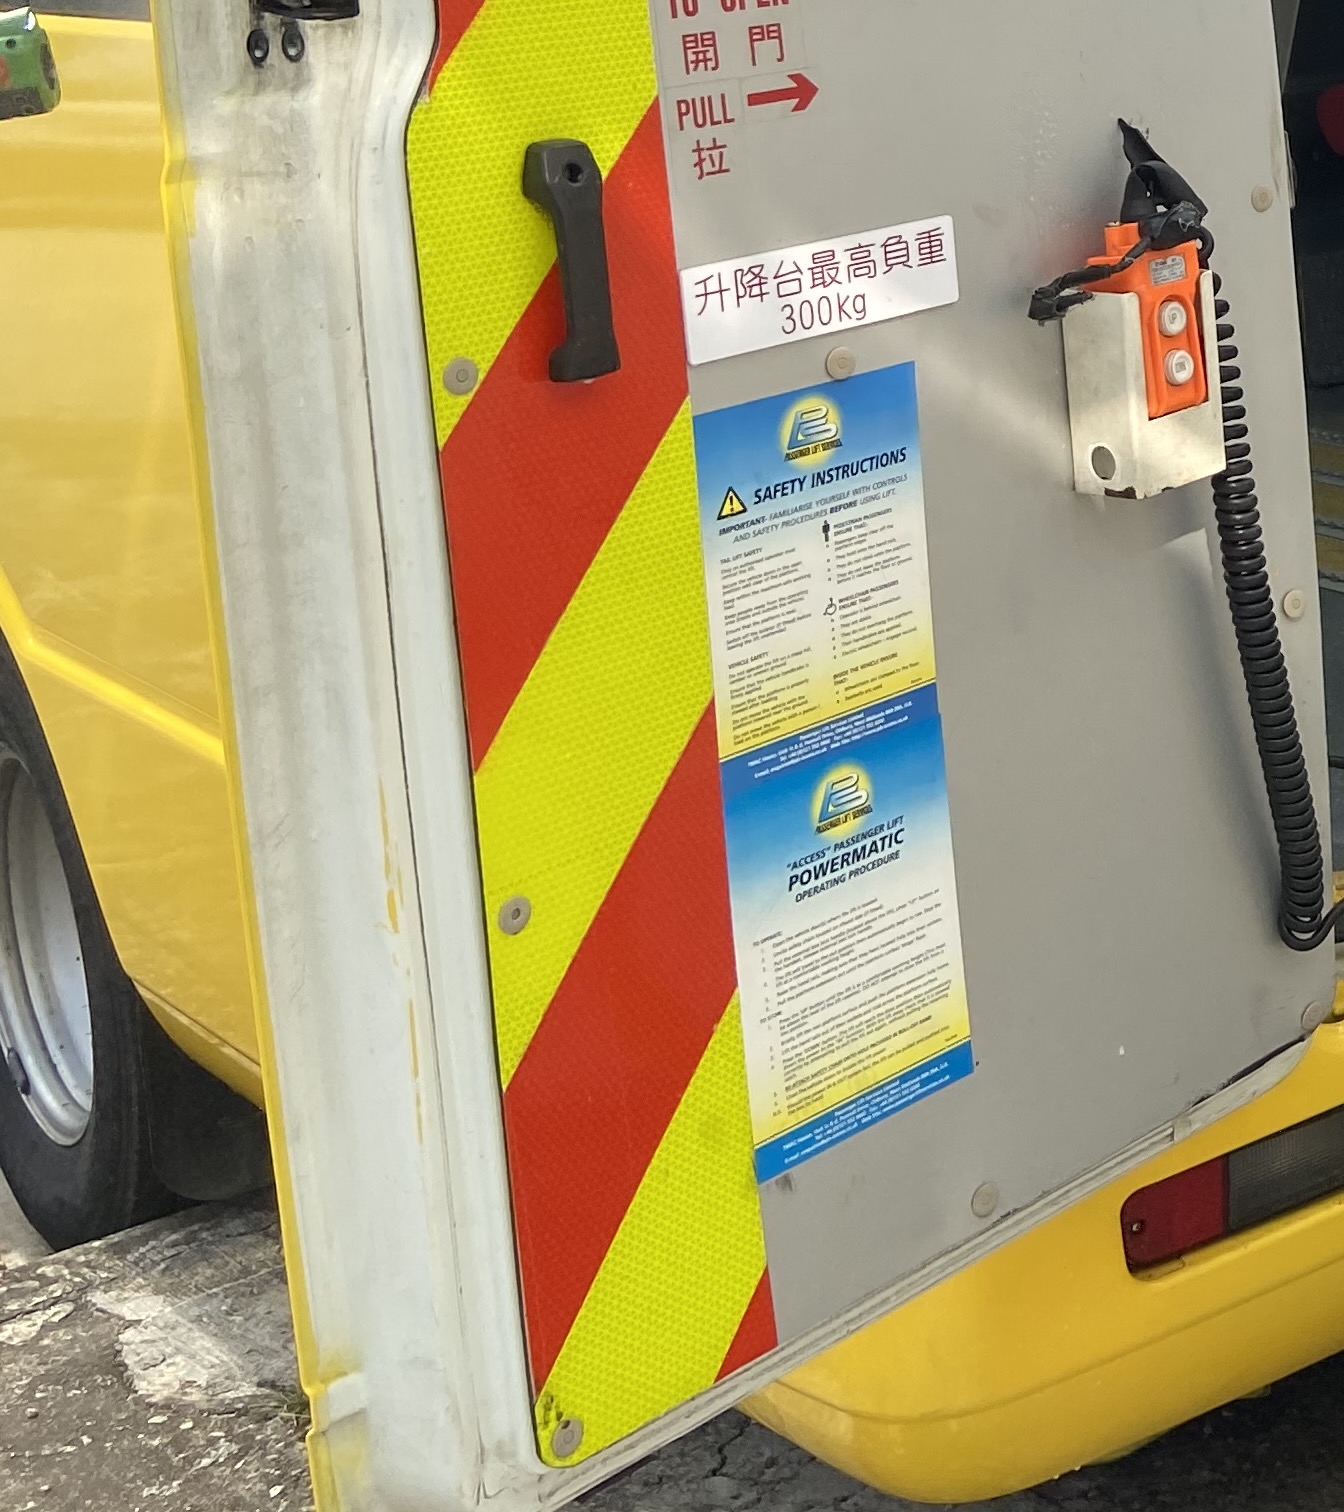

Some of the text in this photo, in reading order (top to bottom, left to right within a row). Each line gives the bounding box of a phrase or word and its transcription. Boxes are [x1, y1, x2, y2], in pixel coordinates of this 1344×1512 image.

[682, 22, 786, 76] 開門
[676, 93, 735, 131] PULL
[691, 137, 731, 181] 拉
[694, 226, 947, 316] 升降台最高負重
[781, 292, 867, 336] 300kg
[753, 447, 907, 505] SAFETY INSTRUCTIONS
[769, 501, 814, 521] FAMILIARISE
[815, 492, 850, 508] YOURSELF
[852, 486, 871, 497] WITH
[872, 473, 908, 492] CONTROLS
[733, 532, 750, 544] AND
[752, 524, 780, 539] SAFETY
[781, 508, 829, 530] PROCEDURES
[829, 500, 859, 514] BEFORE
[860, 493, 882, 506] USING
[833, 823, 885, 853] PASSENGER
[887, 815, 905, 831] LIFT
[788, 828, 905, 892] POWERMATIC
[795, 850, 901, 903] OPERATING PROCEDURE
